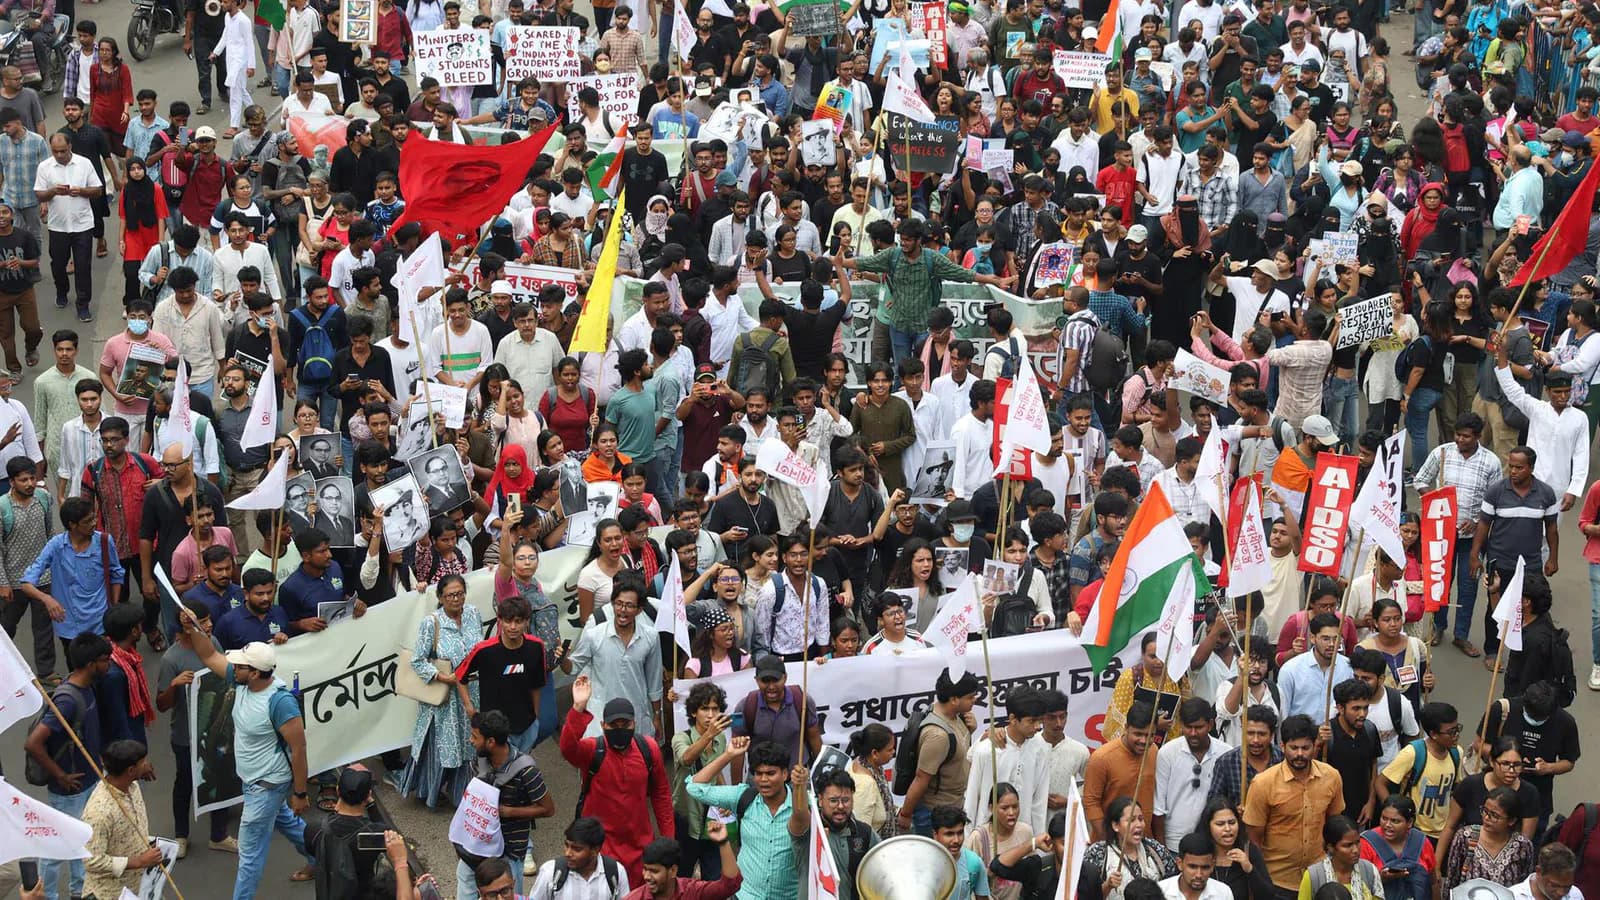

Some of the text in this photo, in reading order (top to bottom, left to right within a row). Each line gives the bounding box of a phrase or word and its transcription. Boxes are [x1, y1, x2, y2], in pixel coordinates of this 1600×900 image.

[417, 33, 475, 45] MINISTERS
[524, 28, 561, 39] SCARED
[540, 40, 560, 49] THE
[418, 46, 443, 59] EAT
[522, 50, 546, 58] INDIA
[438, 58, 490, 71] STUDENTS
[512, 58, 559, 67] STUDENTS
[444, 71, 486, 84] BLEED
[507, 68, 579, 78] GROWING UP IN
[595, 78, 603, 90] B
[614, 89, 636, 100] FOR
[928, 132, 943, 143] this
[1341, 307, 1392, 329] RESISTING
[1345, 308, 1353, 318] IF
[1339, 323, 1393, 347] ASSISTING
[1305, 466, 1350, 567] AIDSO
[1427, 498, 1452, 602] AIDSO
